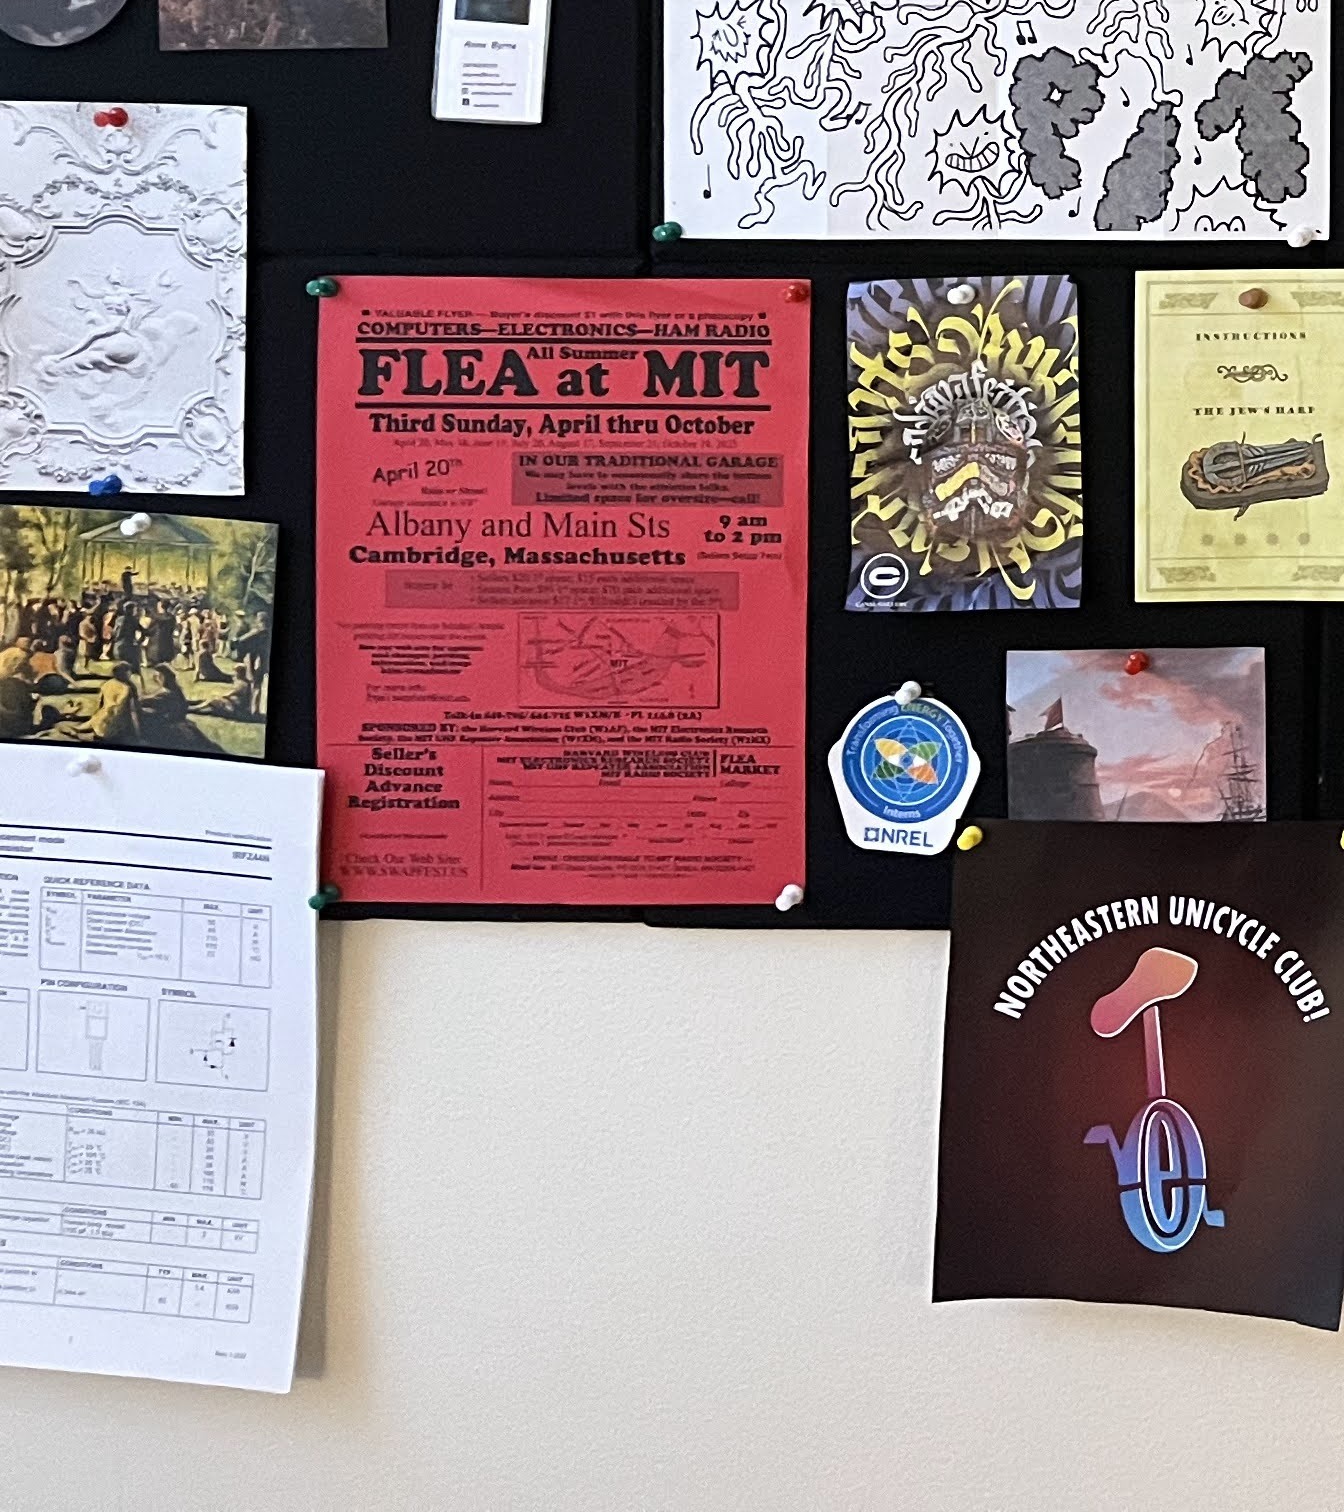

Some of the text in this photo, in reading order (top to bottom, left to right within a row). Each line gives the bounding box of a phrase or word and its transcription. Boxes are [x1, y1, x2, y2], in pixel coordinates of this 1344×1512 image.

[706, 322, 770, 338] RADIO
[1196, 332, 1306, 341] INSTRUCTIONS
[527, 346, 638, 360] All Summer
[358, 349, 769, 397] FLEA at MIT
[1194, 407, 1223, 416] THE
[369, 414, 754, 437] Third Sunday, April thru October
[372, 461, 420, 485] April
[367, 511, 670, 542] Albany and Main Sts
[719, 514, 767, 527] 9 am
[705, 530, 781, 546] to 2 pm
[349, 546, 686, 568] Cambridge, Massachusetts
[364, 764, 444, 776] Discount
[366, 780, 442, 792] Advance
[348, 796, 460, 810] Registration
[881, 828, 933, 847] NREL
[994, 896, 1330, 1023] NORTHEASTERN UNICYCLE CLUB!
